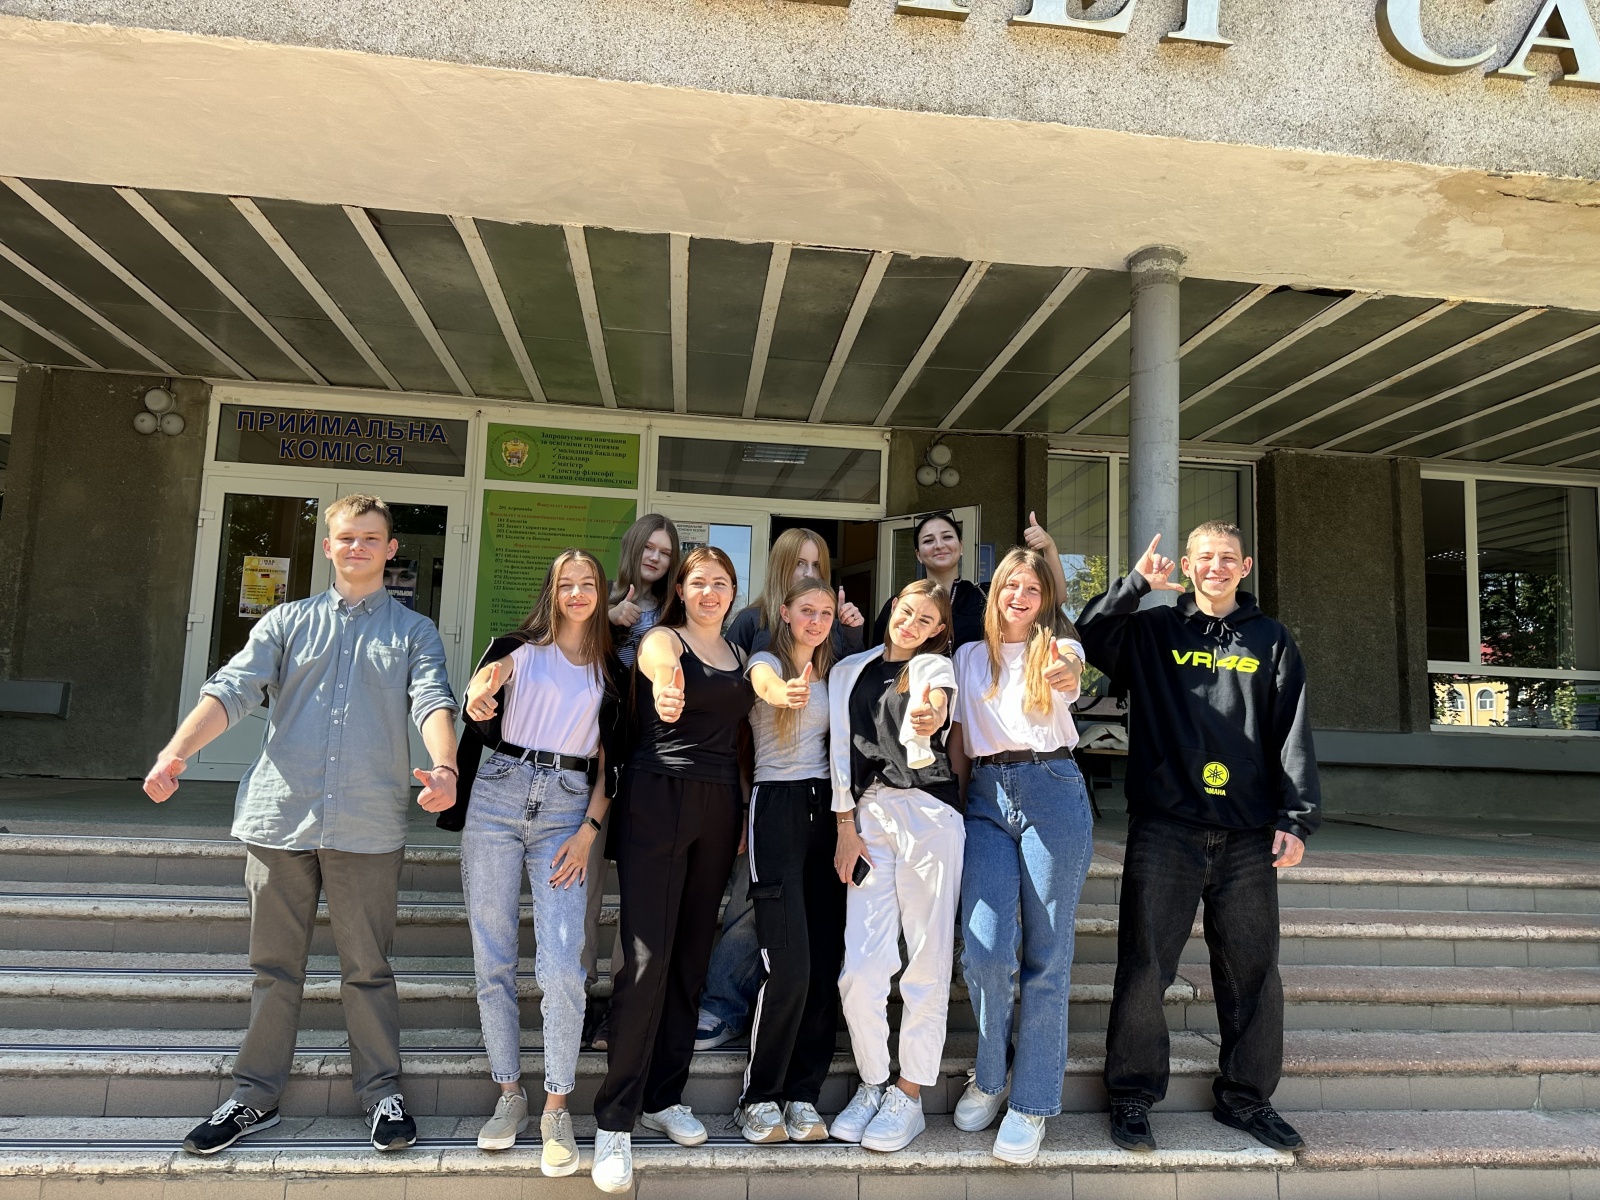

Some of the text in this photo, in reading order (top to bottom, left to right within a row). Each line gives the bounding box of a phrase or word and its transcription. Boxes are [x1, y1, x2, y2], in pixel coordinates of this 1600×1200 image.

[236, 409, 448, 444] ПРИЙМАЛЬНА
[541, 432, 583, 440] Запрошуємо
[279, 438, 404, 466] КОМІСІЯ
[595, 450, 626, 459] бакалавр
[558, 454, 590, 463] бакалавр
